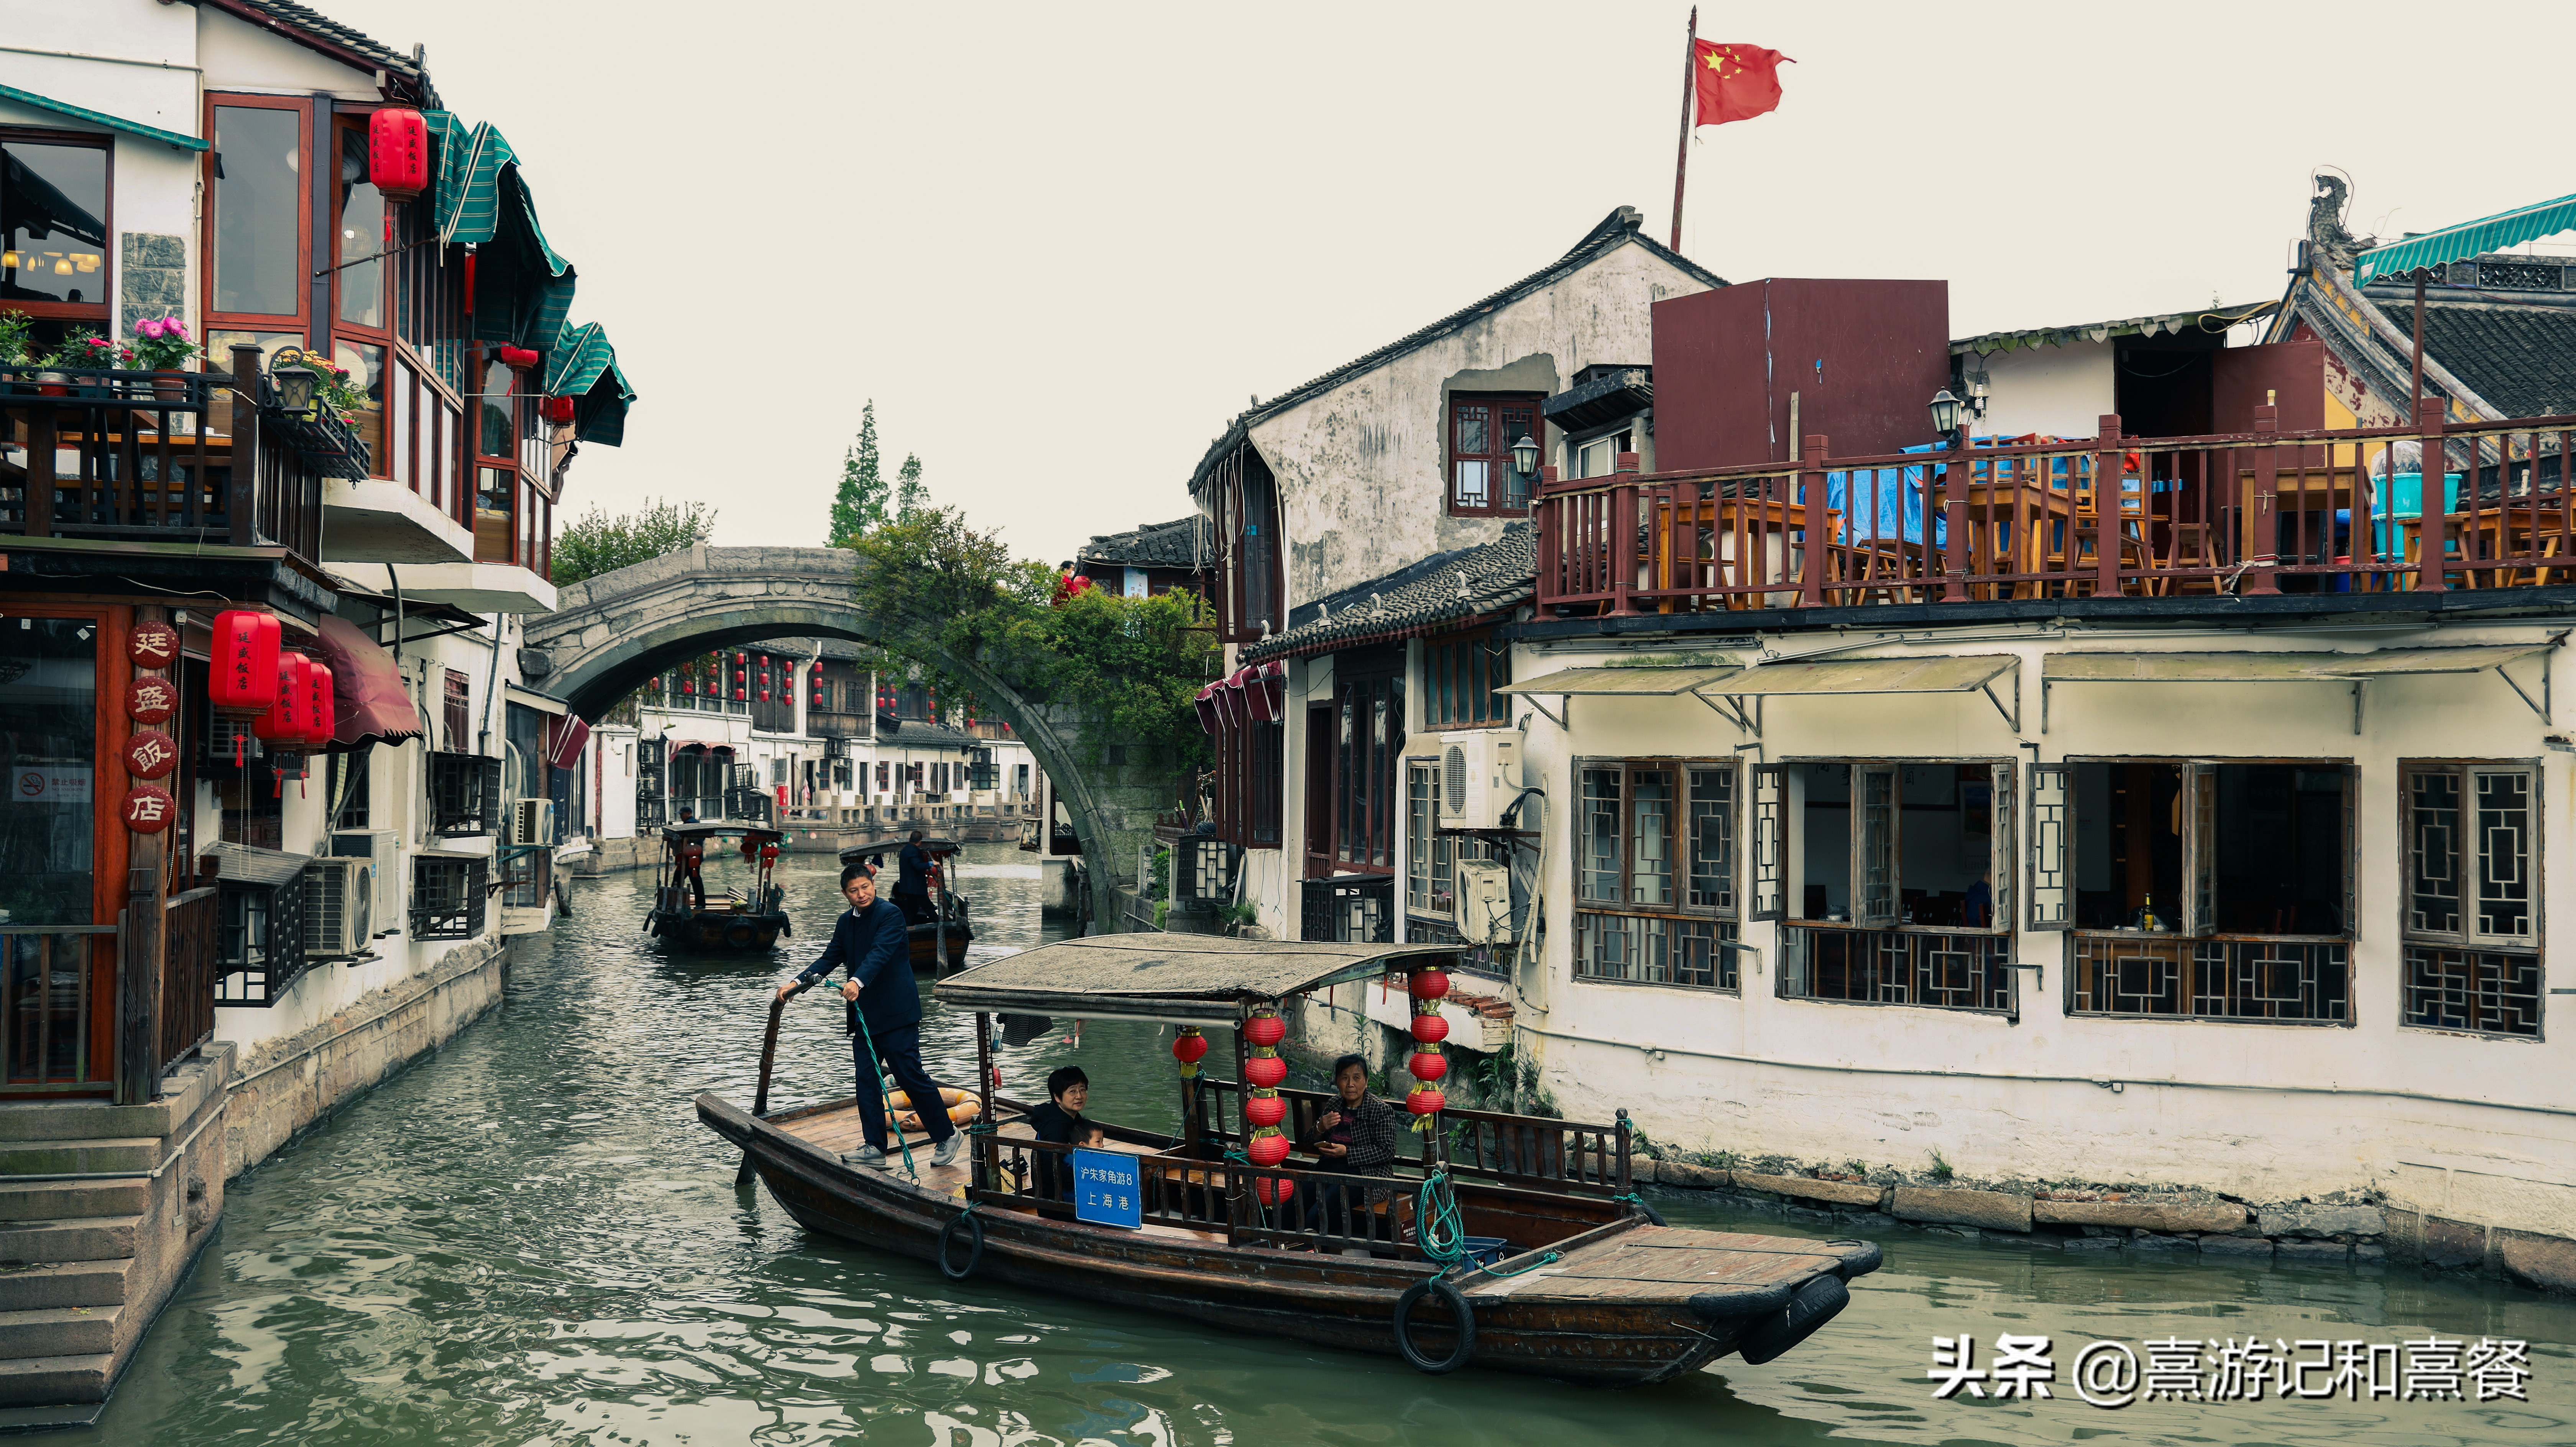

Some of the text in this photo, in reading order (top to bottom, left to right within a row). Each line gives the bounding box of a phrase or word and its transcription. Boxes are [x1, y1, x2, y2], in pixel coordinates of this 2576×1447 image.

[235, 632, 251, 690] 廷盛饭店
[279, 671, 292, 723] 廷盛饭店
[311, 679, 321, 728] 廷盛饭店
[130, 632, 171, 821] 廷盛飯店
[1081, 1166, 1132, 1186] 沪朱家角游8
[1088, 1191, 1129, 1211] 上海港
